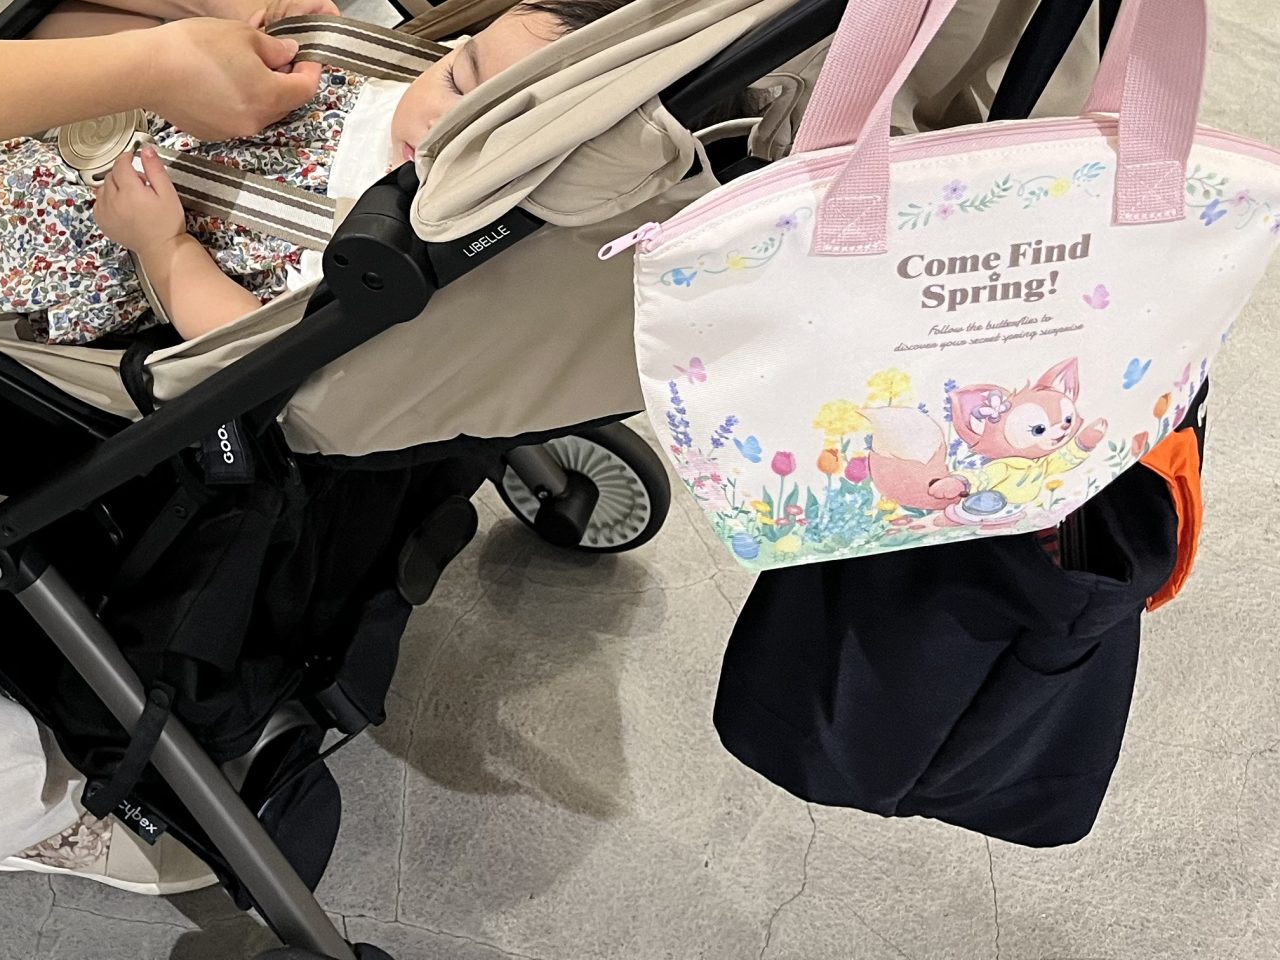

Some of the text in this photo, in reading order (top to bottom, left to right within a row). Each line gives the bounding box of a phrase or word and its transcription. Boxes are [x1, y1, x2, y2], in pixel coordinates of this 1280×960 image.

[463, 225, 511, 257] LIBELLE
[896, 233, 1092, 280] Come Find
[921, 270, 1059, 312] Spring!
[893, 323, 1085, 353] discover your secret spring surprise
[928, 313, 1054, 336] Follow the butterflies to
[217, 424, 234, 464] GOO
